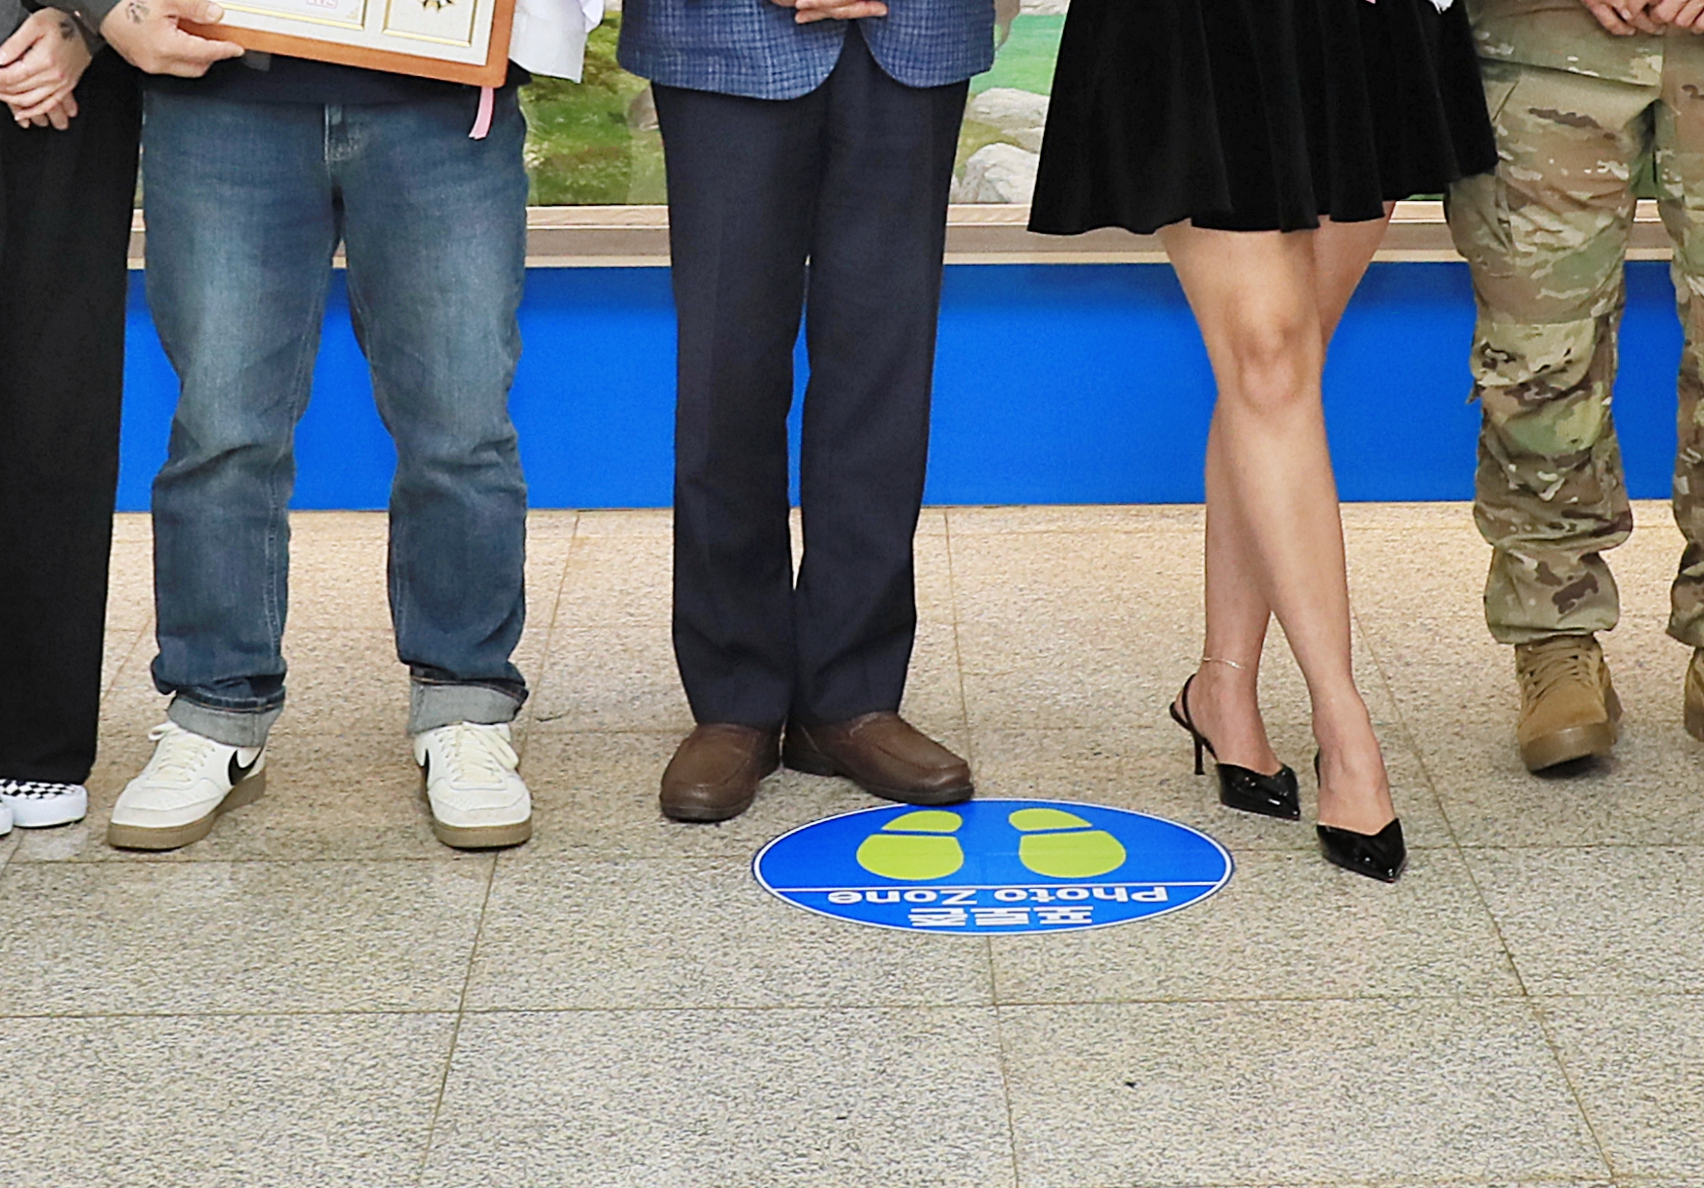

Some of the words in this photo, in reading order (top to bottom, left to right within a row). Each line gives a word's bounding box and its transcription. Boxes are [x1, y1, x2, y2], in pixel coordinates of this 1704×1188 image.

[828, 889, 977, 906] Zone
[993, 887, 1168, 903] Photo
[908, 906, 1094, 927] 포토존
